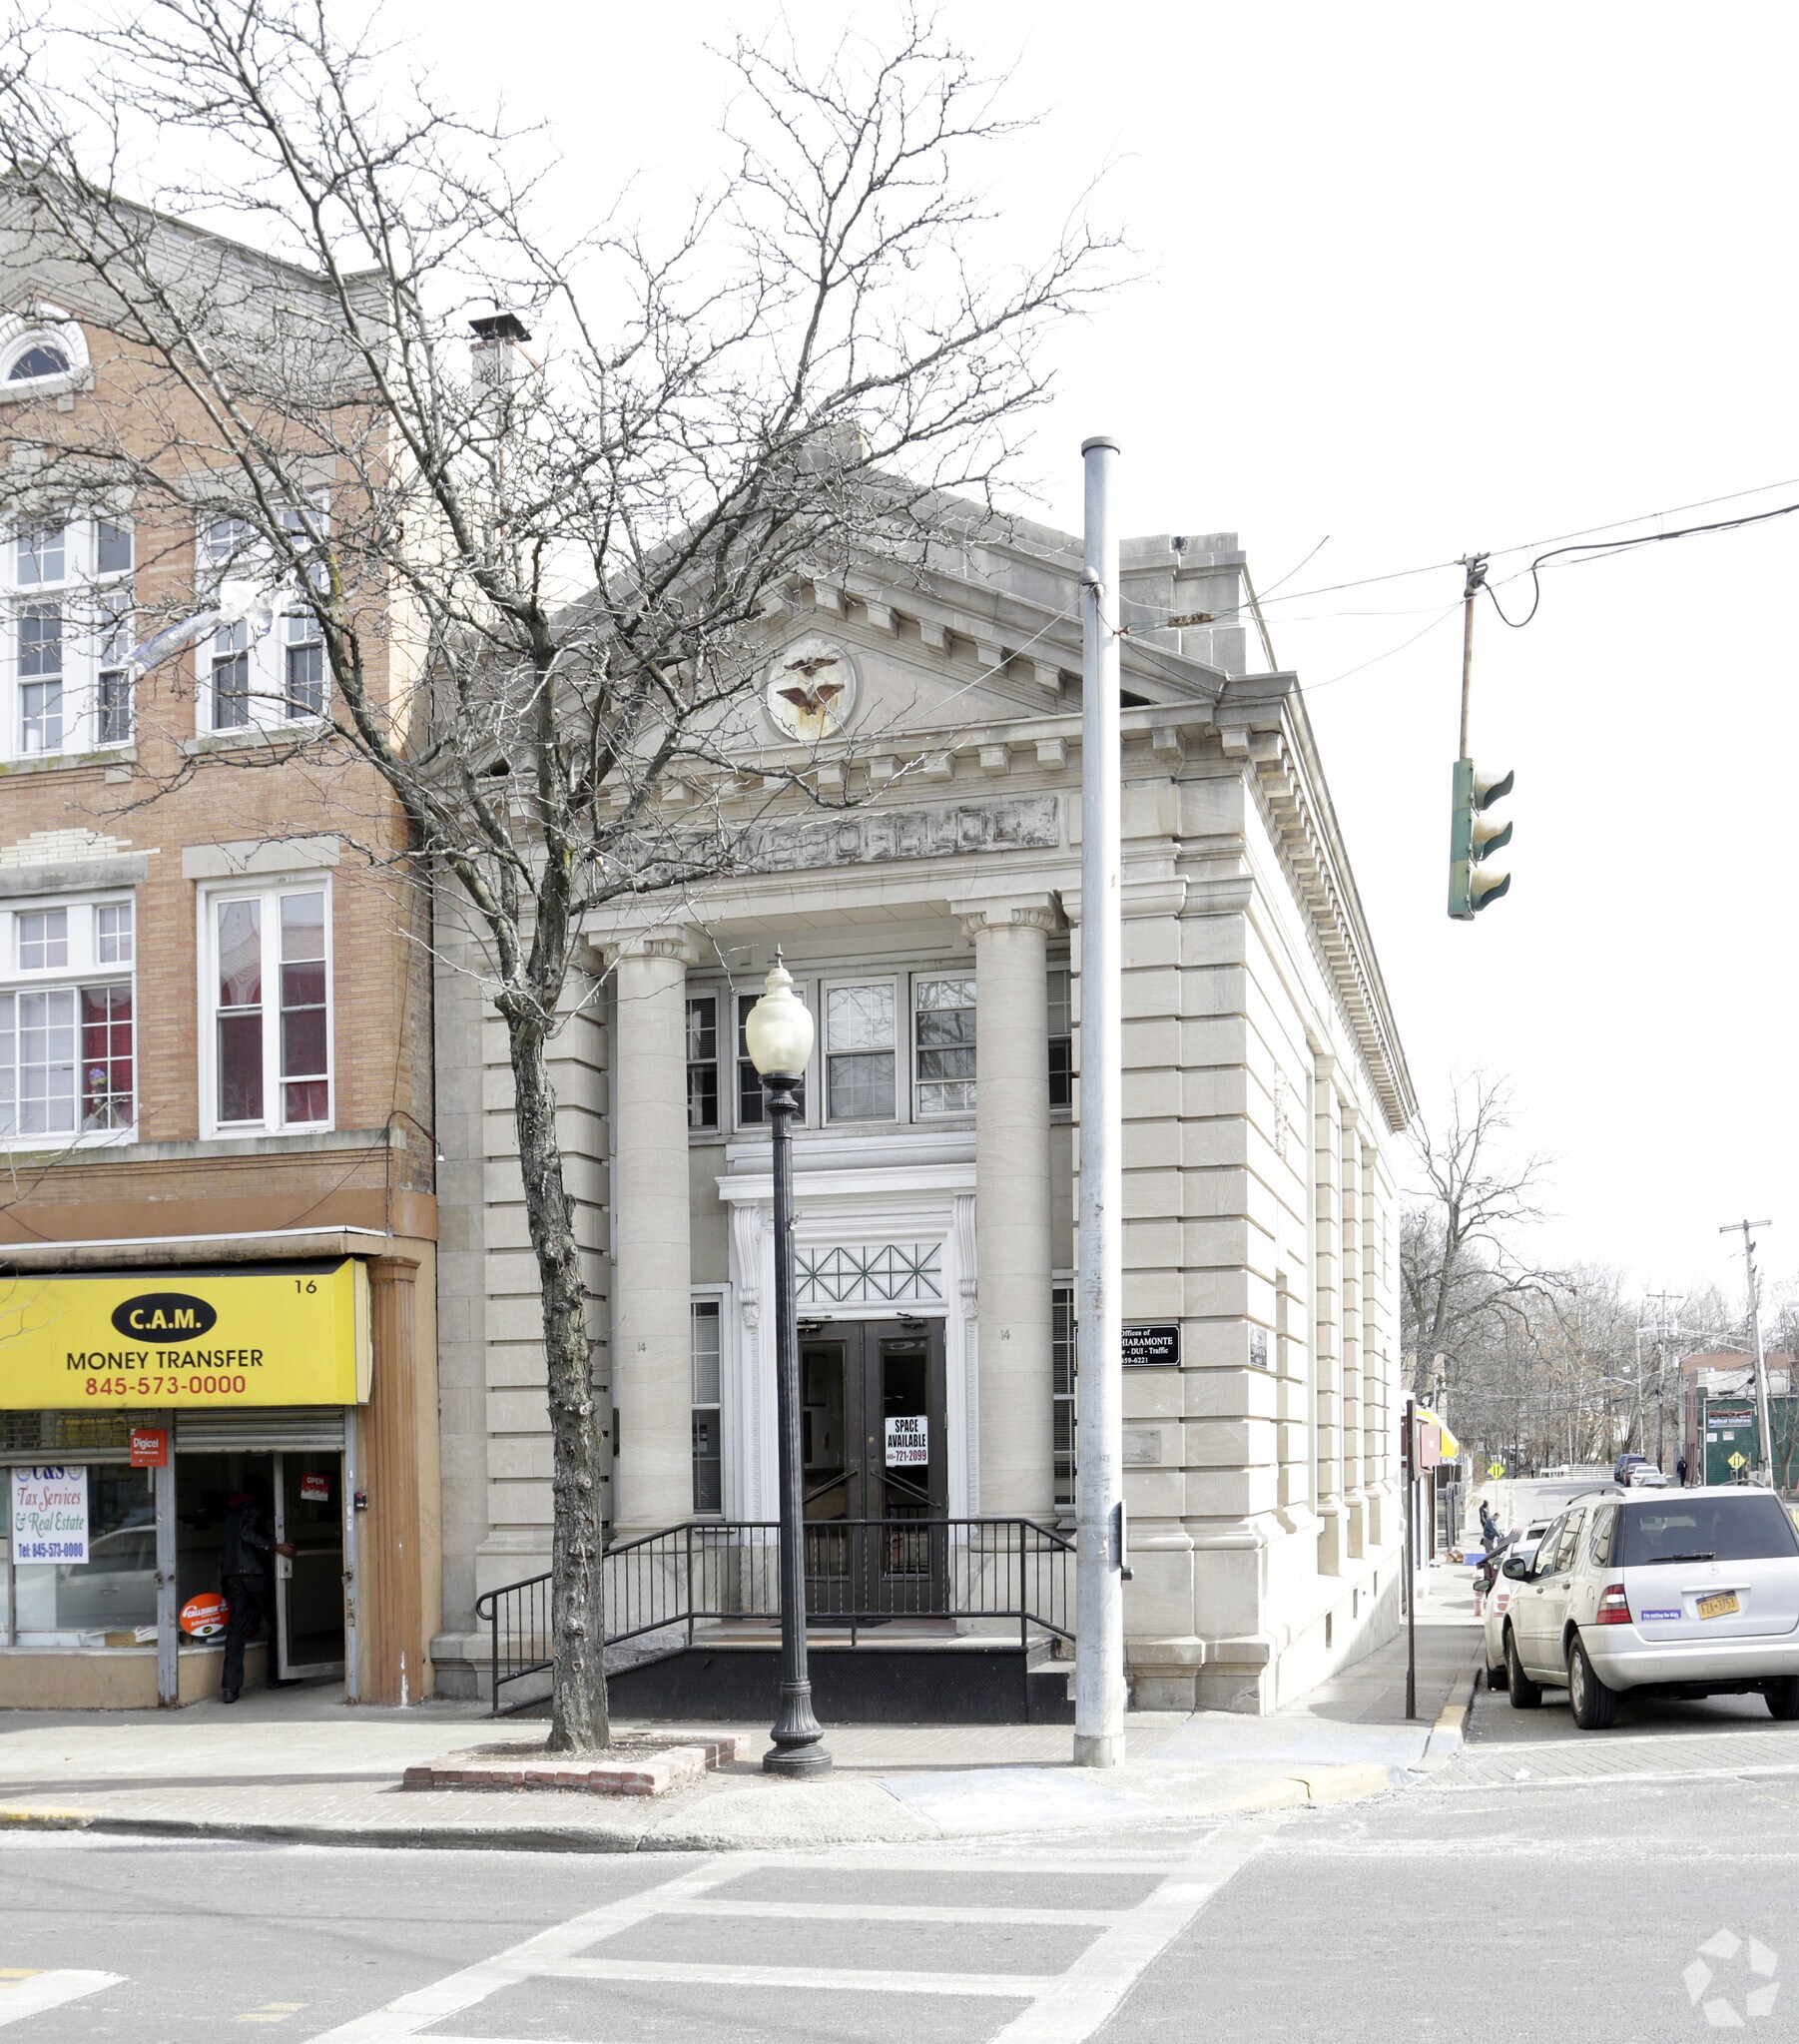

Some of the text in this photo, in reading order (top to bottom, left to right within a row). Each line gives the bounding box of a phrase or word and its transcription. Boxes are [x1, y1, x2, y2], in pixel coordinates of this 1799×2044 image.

[295, 1279, 317, 1294] 16
[129, 1308, 202, 1330] C.A.M.
[1001, 1329, 1011, 1341] 14
[1121, 1337, 1173, 1346] HIARAMONTE
[637, 1342, 647, 1352] 14
[67, 1349, 264, 1370] MONEY TRANSFER
[85, 1375, 247, 1395] 845-573-0000
[895, 1419, 918, 1433] SPACE
[133, 1438, 159, 1450] Digicel
[888, 1434, 926, 1448] AVAILABLE
[17, 1487, 82, 1512] Tax Services
[15, 1512, 85, 1538] & Real Estate
[18, 1543, 83, 1558] Tel: 845-573-0000
